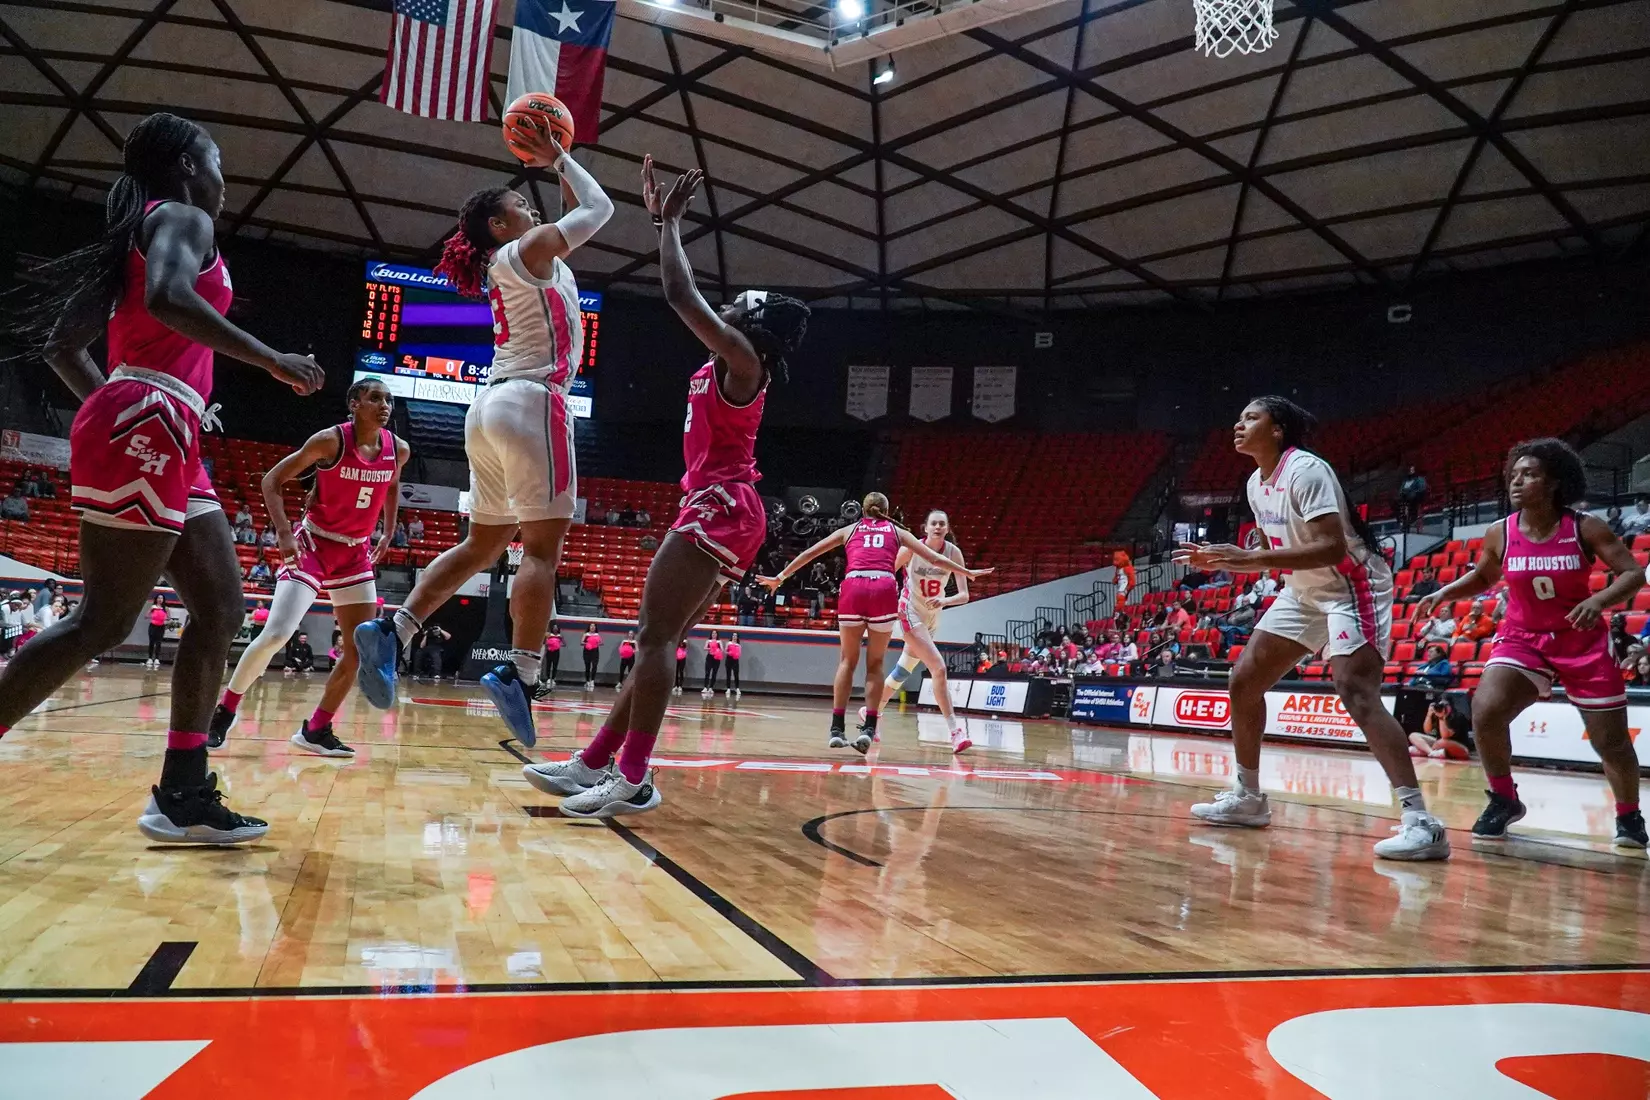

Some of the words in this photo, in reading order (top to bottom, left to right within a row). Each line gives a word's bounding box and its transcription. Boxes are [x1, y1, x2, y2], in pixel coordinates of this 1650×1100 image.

[376, 268, 410, 280] BUD
[388, 285, 400, 294] PTS
[362, 330, 371, 339] 10
[1034, 332, 1053, 348] B
[446, 361, 454, 373] 0
[340, 466, 359, 481] SAM
[360, 469, 394, 483] HOUSTON
[355, 486, 374, 509] 5
[863, 533, 885, 548] 10
[1508, 557, 1526, 572] SAM
[1528, 554, 1581, 571] HOUSTON
[919, 578, 941, 597] 18
[1532, 576, 1556, 600] 0
[991, 685, 1005, 696] BUD
[986, 696, 1006, 707] LIGHT
